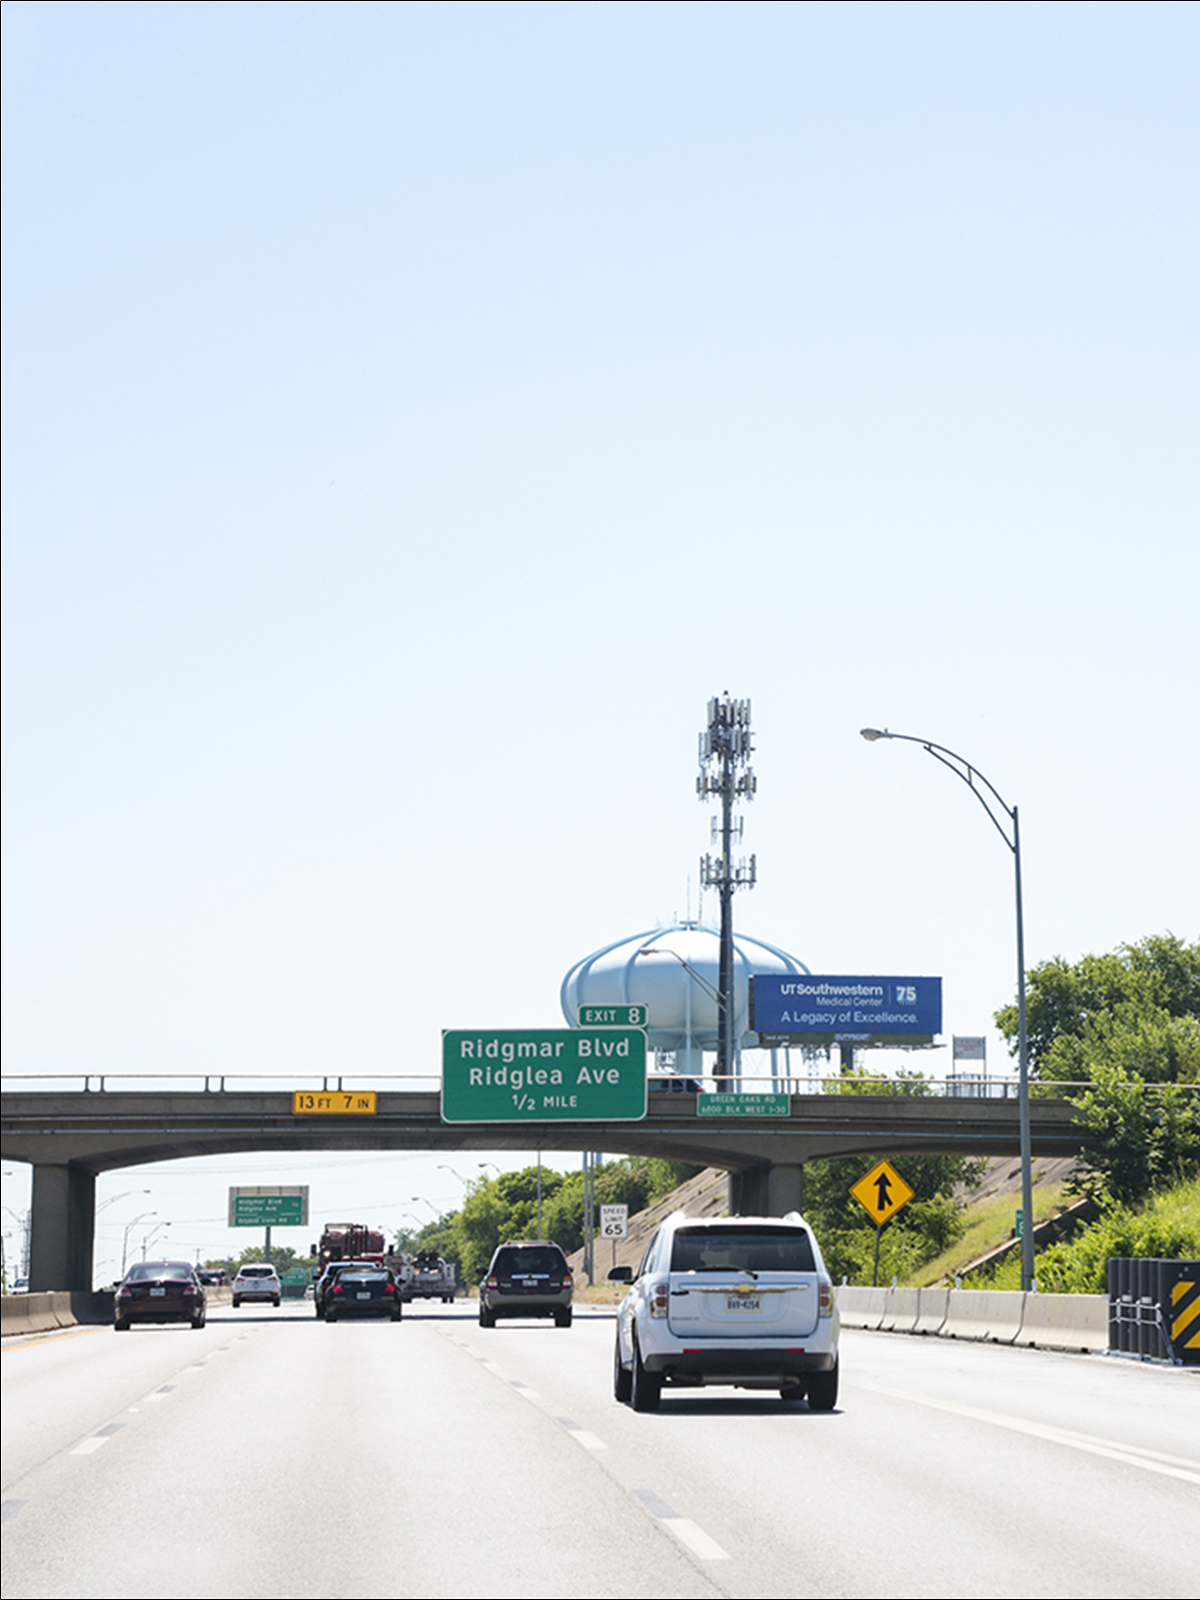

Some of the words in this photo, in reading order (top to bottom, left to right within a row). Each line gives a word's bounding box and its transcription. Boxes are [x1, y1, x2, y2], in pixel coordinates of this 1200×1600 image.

[797, 983, 883, 996] Southwestern
[896, 986, 917, 1001] 75
[816, 997, 851, 1006] Medical
[853, 997, 883, 1006] Center
[585, 1010, 616, 1022] EXIT
[628, 1007, 640, 1024] 8
[781, 1011, 791, 1022] A
[794, 1011, 836, 1025] Legacy
[838, 1011, 850, 1023] of
[854, 1011, 918, 1023] Excellence.
[460, 1039, 564, 1062] Ridgmar
[577, 1038, 629, 1057] Blvd
[469, 1066, 563, 1090] Ridglea
[576, 1066, 620, 1084] Ave
[299, 1095, 314, 1109] 13
[318, 1098, 331, 1108] FT
[343, 1095, 353, 1109] 7
[358, 1098, 369, 1108] IN
[512, 1094, 535, 1110] 1/2
[543, 1095, 578, 1107] MILE
[710, 1095, 735, 1103] GREEN
[745, 1105, 765, 1113] WEST
[605, 1224, 623, 1236] 65
